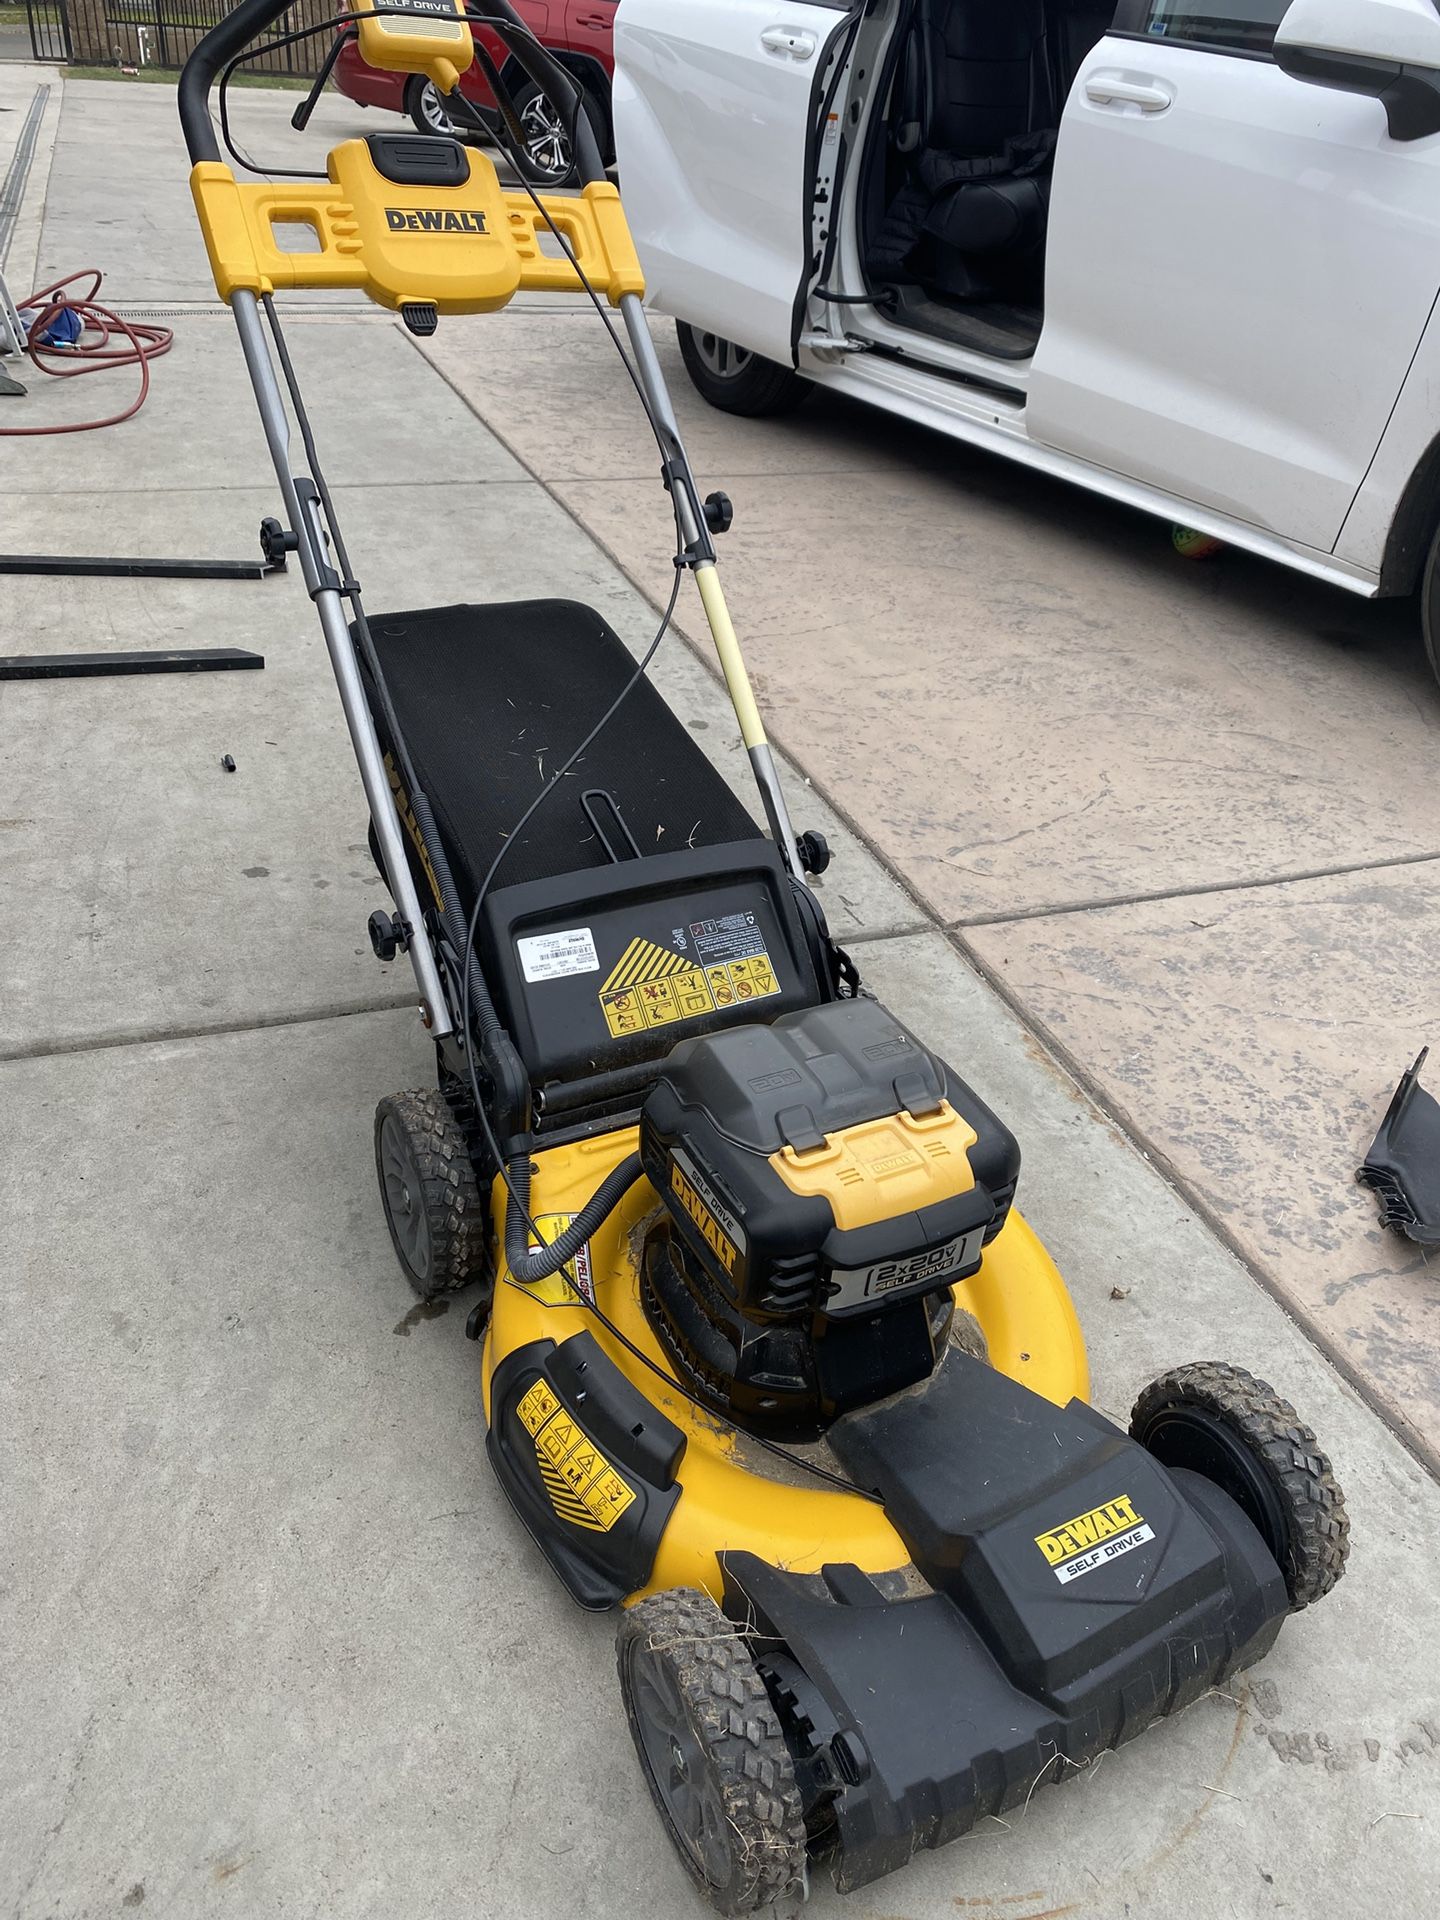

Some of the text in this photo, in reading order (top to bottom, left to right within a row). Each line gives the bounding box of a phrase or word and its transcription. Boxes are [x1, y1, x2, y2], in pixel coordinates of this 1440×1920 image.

[413, 1, 451, 12] DRIVE
[690, 1170, 735, 1232] SELF DRIVE
[877, 1257, 955, 1291] SELF DRIVE
[1066, 1530, 1145, 1577] SELF DRIVE
